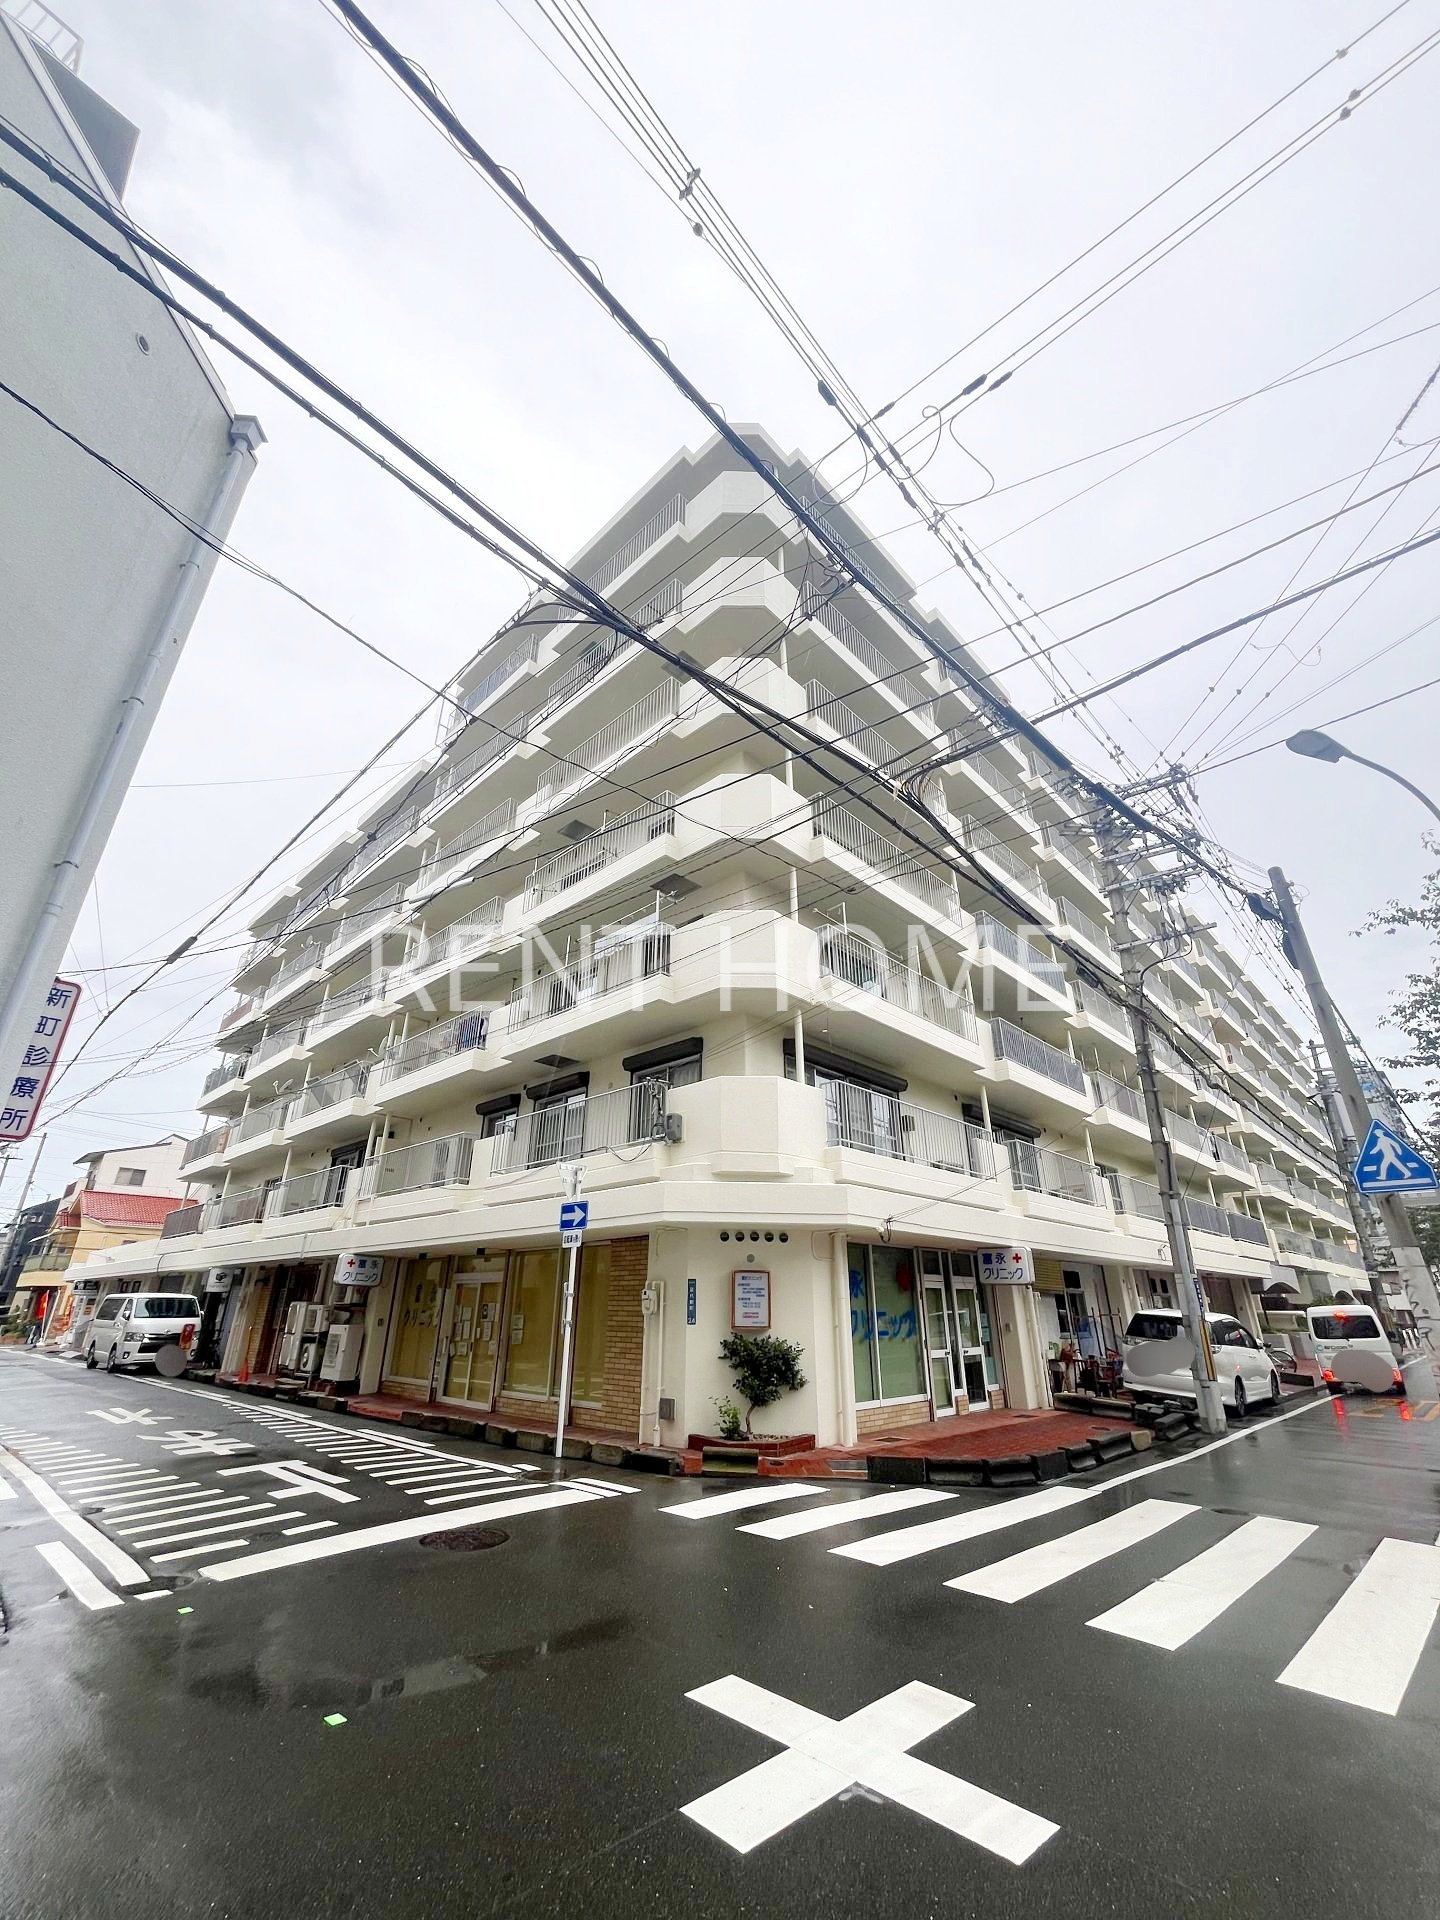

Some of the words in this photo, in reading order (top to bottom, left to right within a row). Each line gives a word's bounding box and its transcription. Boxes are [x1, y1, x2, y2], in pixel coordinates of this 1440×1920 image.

[0, 986, 72, 1131] 新町診療所
[983, 1267, 1024, 1280] クリニック
